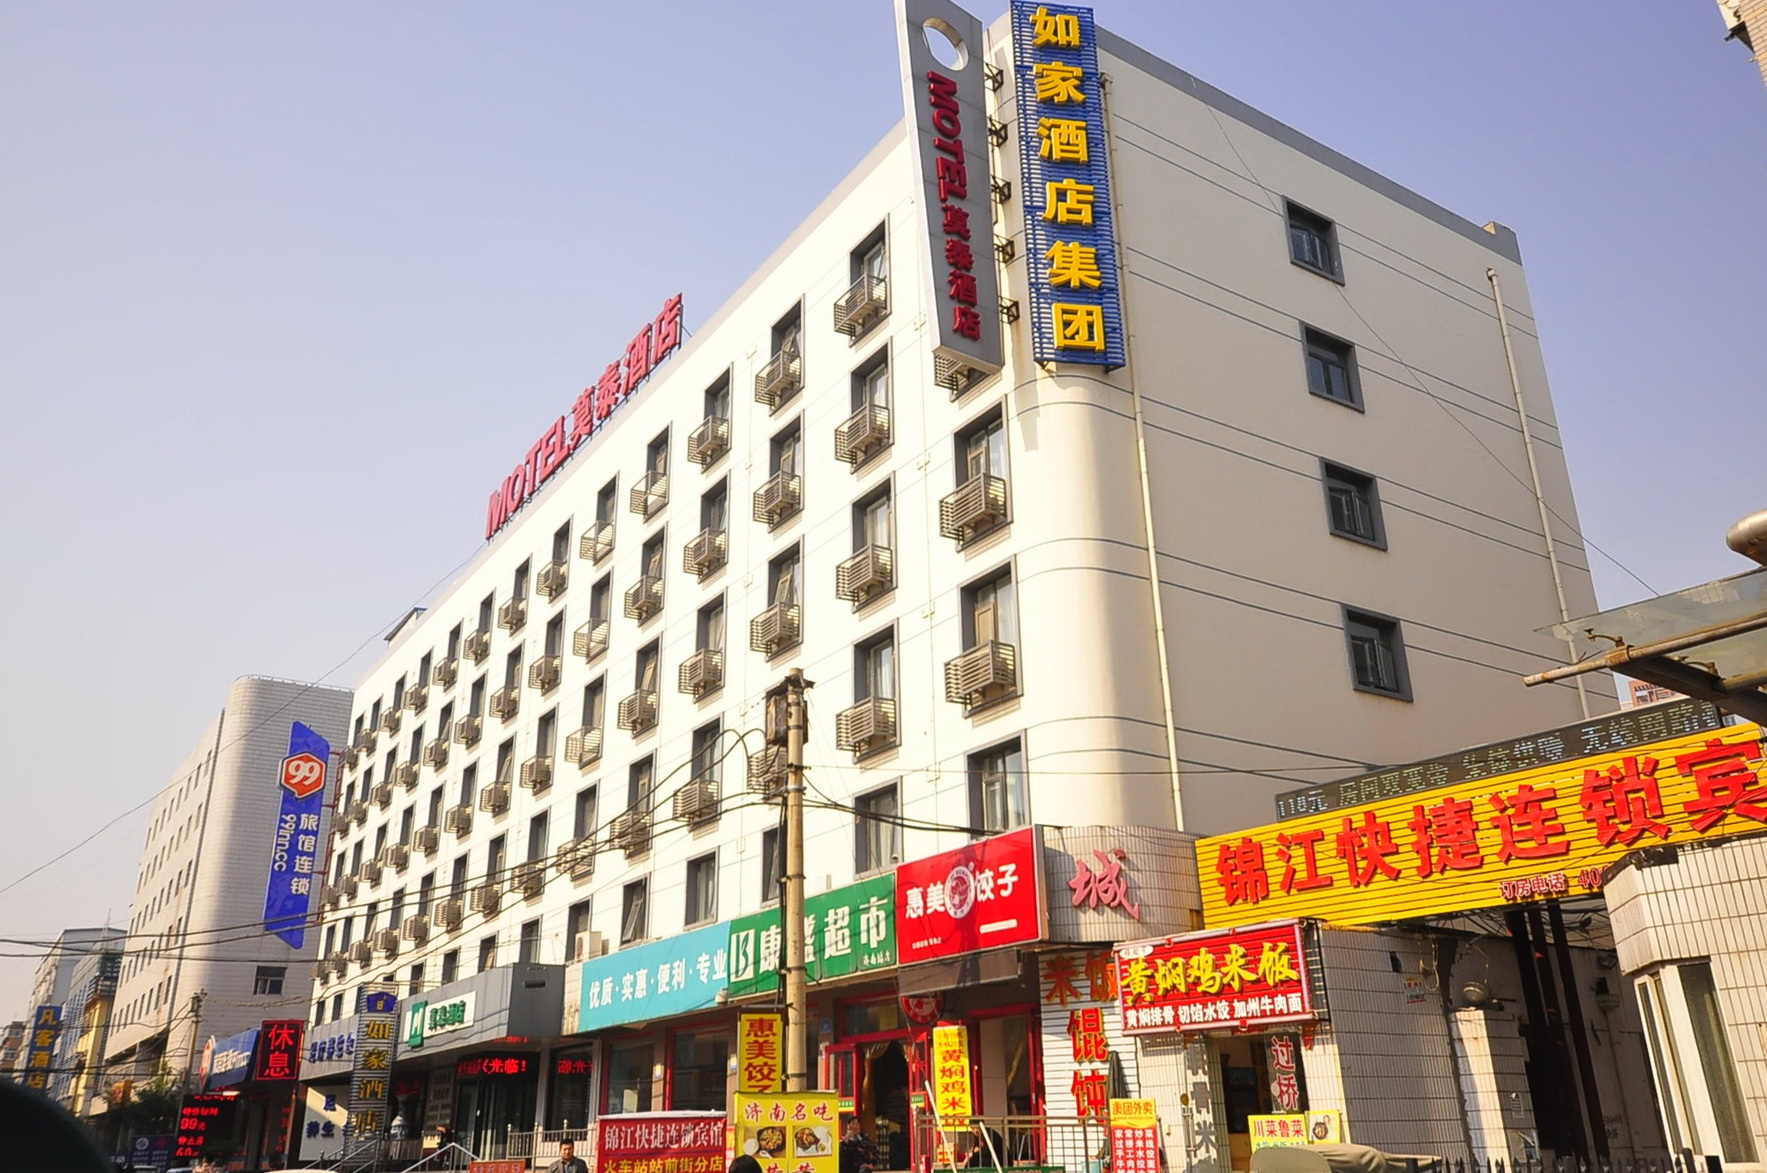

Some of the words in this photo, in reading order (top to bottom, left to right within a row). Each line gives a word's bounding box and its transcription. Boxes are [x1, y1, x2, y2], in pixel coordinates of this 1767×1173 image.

[927, 71, 967, 201] MOTEL
[1030, 7, 1105, 352] 如家酒店集团
[942, 204, 981, 341] 莫泰酒店
[486, 415, 571, 540] MOTEL
[570, 292, 682, 450] 莫泰酒店
[288, 760, 320, 785] 99
[274, 814, 297, 872] 99inn.cc
[290, 813, 319, 895] 旅馆连锁
[906, 882, 946, 919] 惠美
[975, 863, 1018, 902] 饺子
[1068, 848, 1140, 922] 城
[1499, 872, 1565, 898] 订房电话
[1121, 941, 1299, 1006] 黄焖鸡米饭
[1125, 1005, 1174, 1028] 黄焖排骨
[1233, 993, 1302, 1019] 加州牛肉面
[264, 1024, 294, 1077] 休息
[355, 1019, 392, 1133] 如家酒店
[1271, 1036, 1299, 1110] 过桥
[745, 1102, 833, 1123] 济南名吃
[940, 1050, 966, 1126] 黄焖鸡米饭
[1113, 1101, 1153, 1115] 美团外卖
[604, 1121, 723, 1151] 锦江快捷连锁宾馆
[1254, 1120, 1304, 1138] 川菜鲁菜
[604, 1156, 723, 1173] 火车站站前街分店
